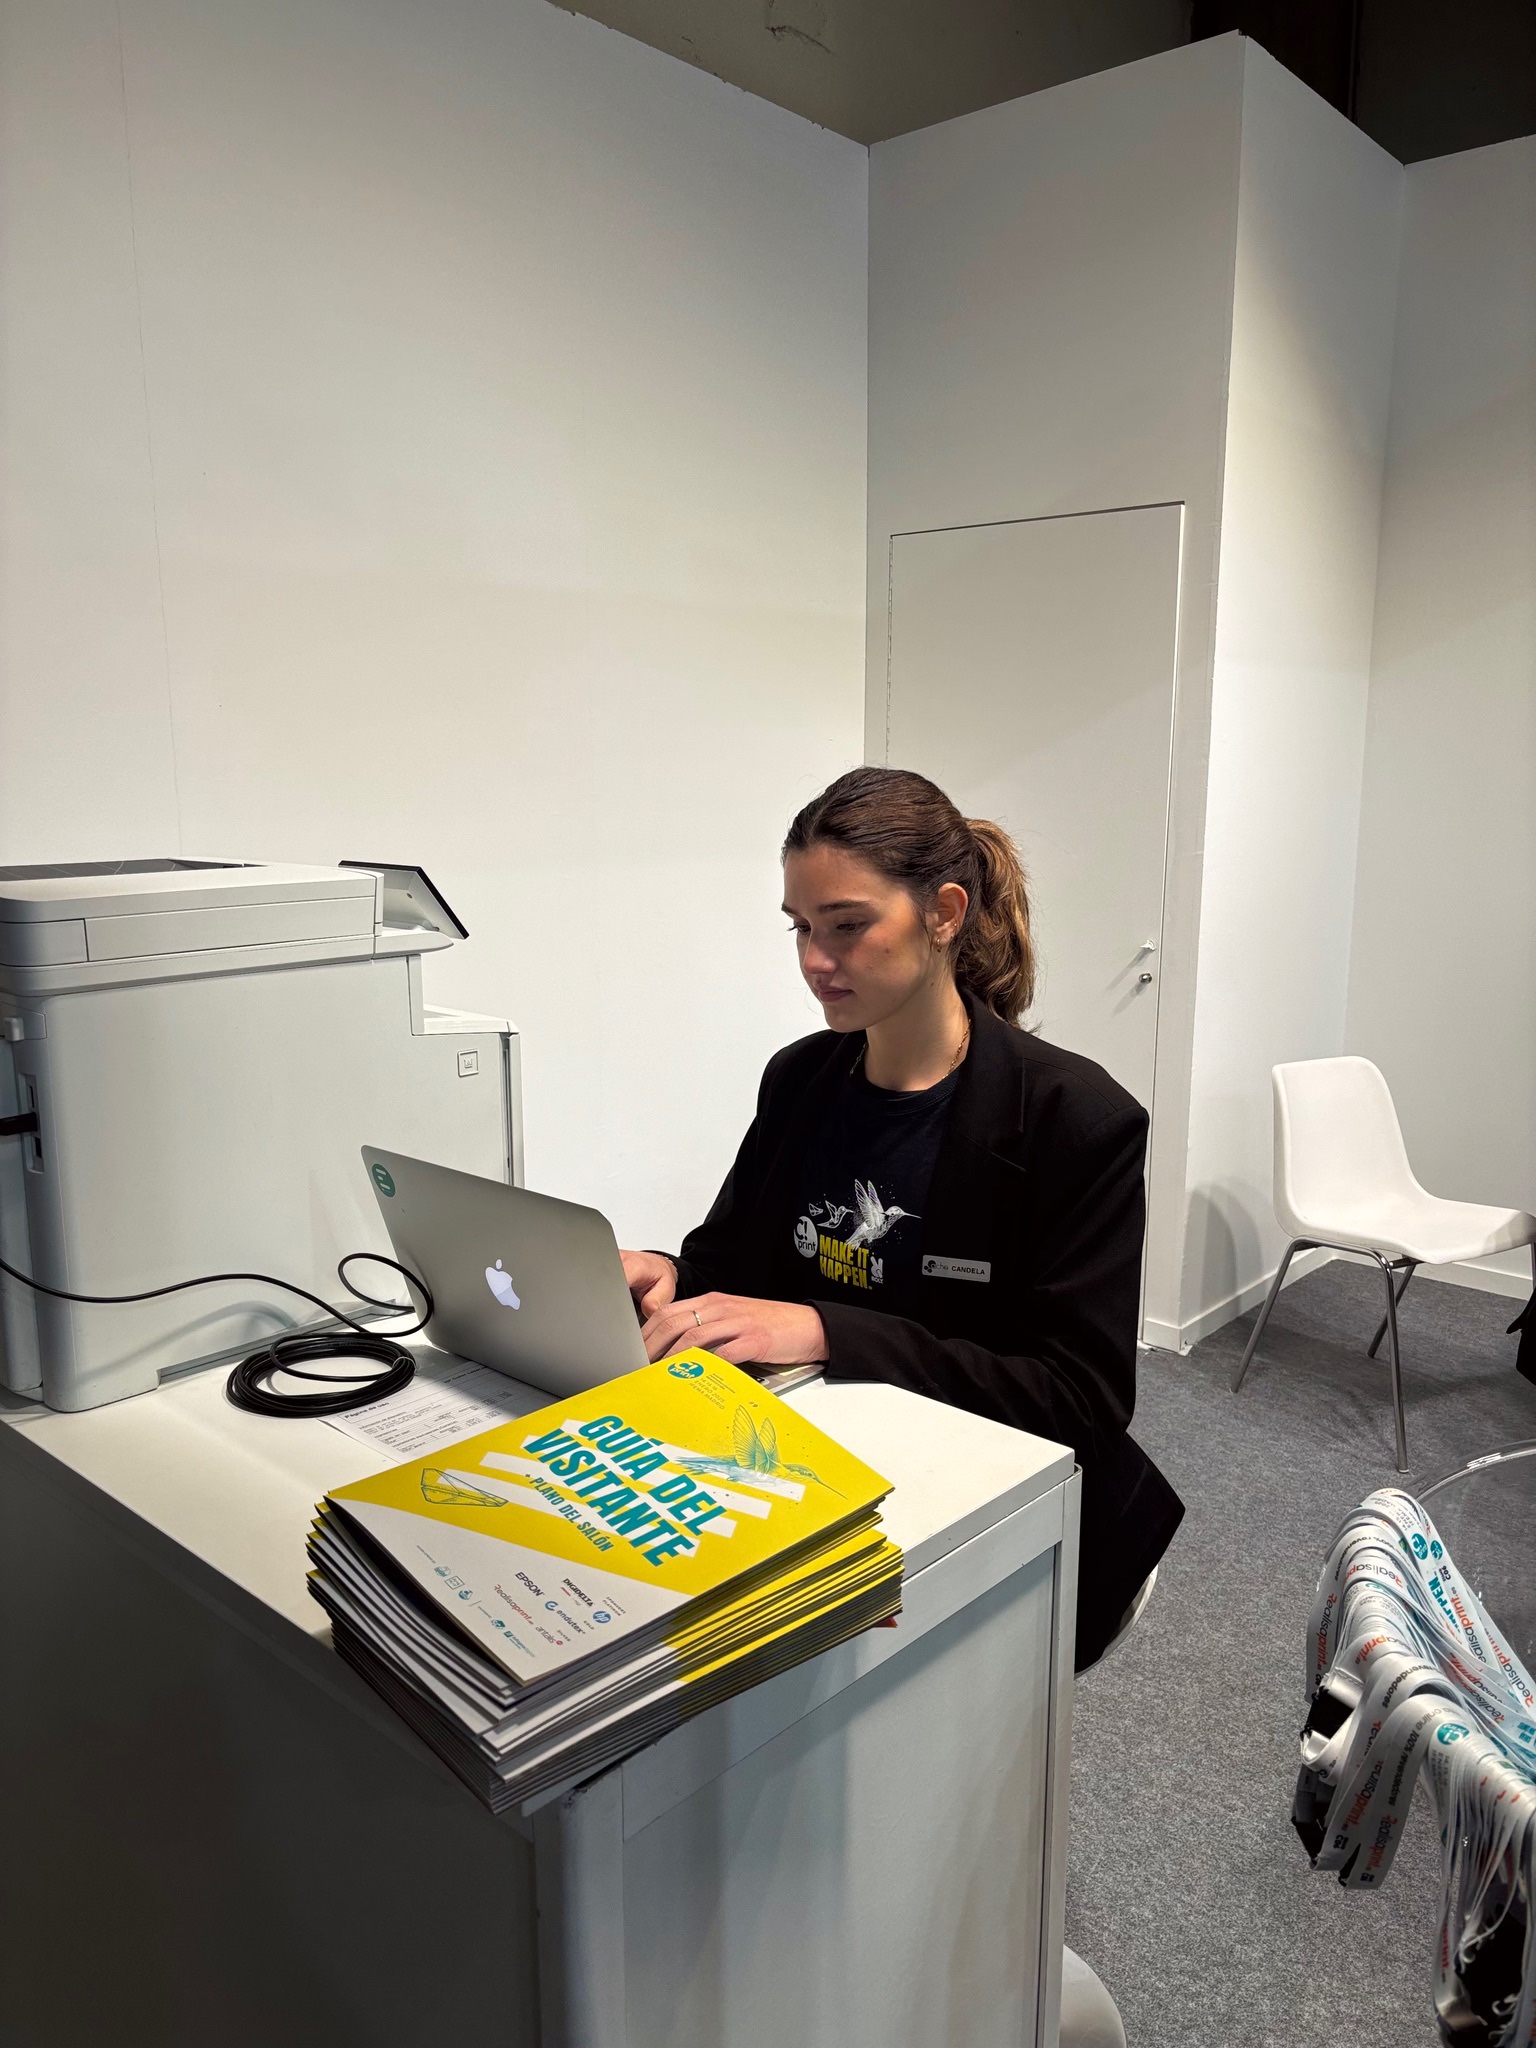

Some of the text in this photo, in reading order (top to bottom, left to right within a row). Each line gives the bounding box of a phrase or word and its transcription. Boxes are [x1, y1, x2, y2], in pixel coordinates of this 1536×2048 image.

[795, 1218, 808, 1241] C!
[797, 1240, 817, 1252] print
[819, 1234, 870, 1269] MAKE IT
[951, 1265, 985, 1275] CANDELA
[669, 1366, 695, 1379] print
[578, 1415, 670, 1481] GUÍA
[647, 1473, 728, 1537] DEL
[523, 1427, 696, 1567] VISITANTE
[529, 1477, 562, 1506] PLANO
[558, 1503, 582, 1524] DEL
[576, 1521, 614, 1552] SALÓN
[515, 1572, 543, 1597] EPSON
[1442, 1565, 1451, 1580] C06
[562, 1578, 594, 1607] DIGIDELTA
[1451, 1586, 1487, 1664] ealisaprint.es
[1388, 1708, 1442, 1806] online 100% revendedores
[1333, 1834, 1344, 1849] C06
